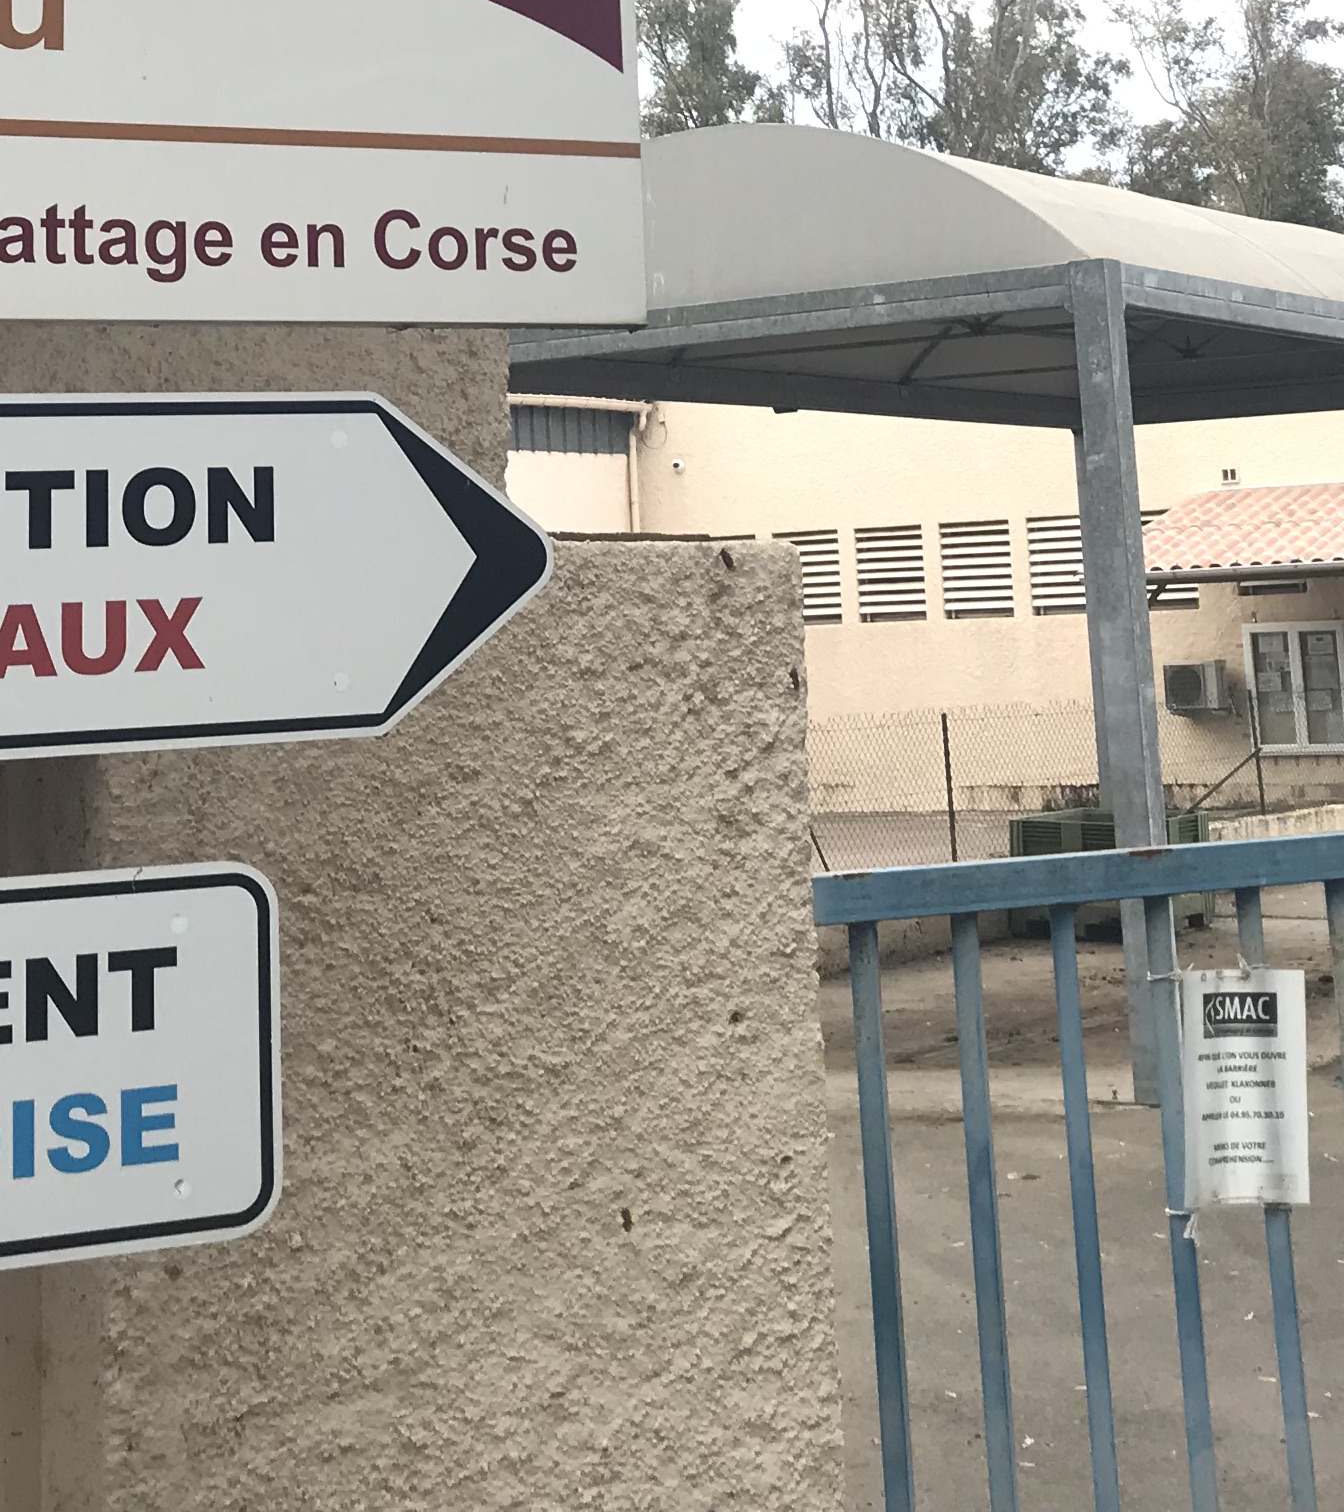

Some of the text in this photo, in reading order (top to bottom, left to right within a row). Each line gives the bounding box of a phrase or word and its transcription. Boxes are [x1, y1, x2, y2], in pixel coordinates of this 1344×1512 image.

[260, 222, 346, 268] en
[373, 209, 578, 273] Corse
[1215, 996, 1270, 1020] SMAC
